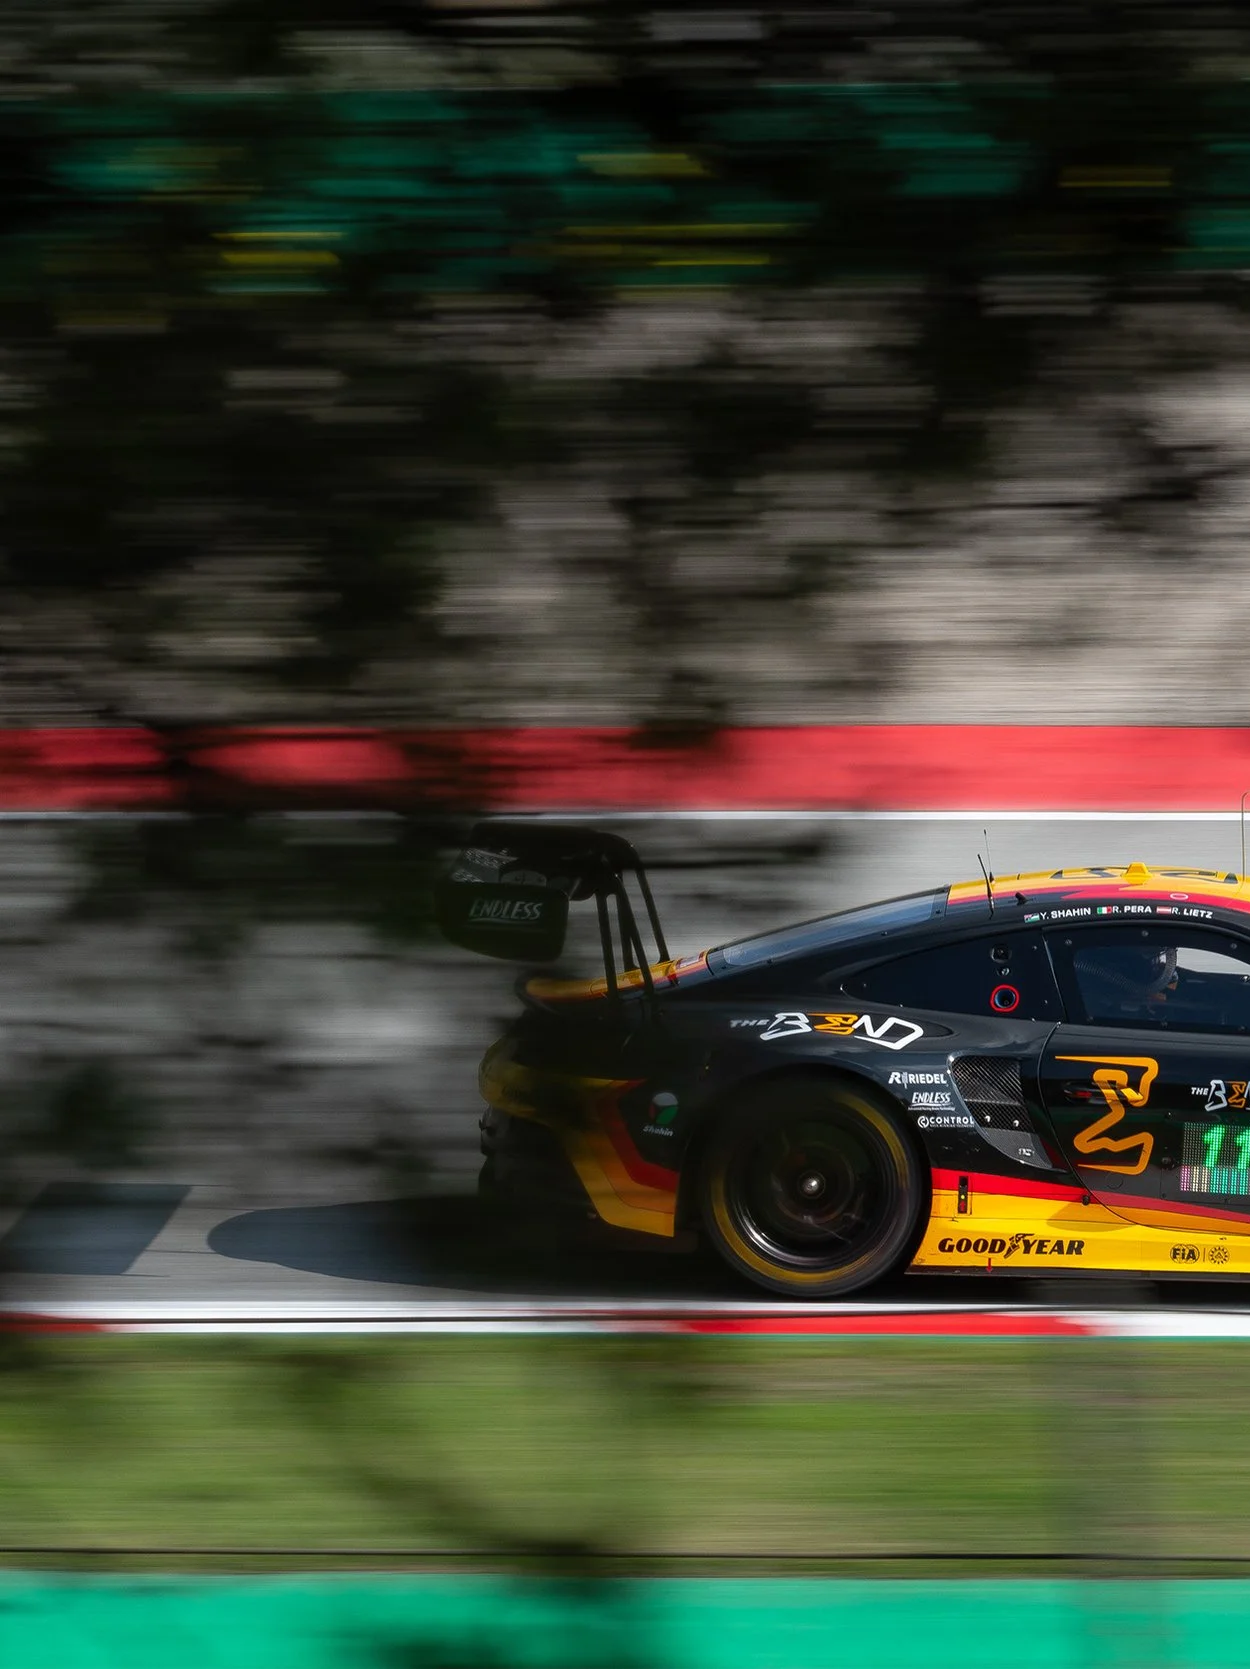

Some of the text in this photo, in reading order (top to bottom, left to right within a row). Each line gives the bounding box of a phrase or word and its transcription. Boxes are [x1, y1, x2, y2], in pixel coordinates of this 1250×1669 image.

[1051, 907, 1091, 919] SHAHIN
[1124, 905, 1152, 913] PERA
[1183, 908, 1213, 919] LIETZ
[908, 1073, 948, 1084] RIEDEL
[1191, 1087, 1209, 1095] THE
[912, 1092, 951, 1104] ENDLESS
[930, 1116, 975, 1125] CONTROL
